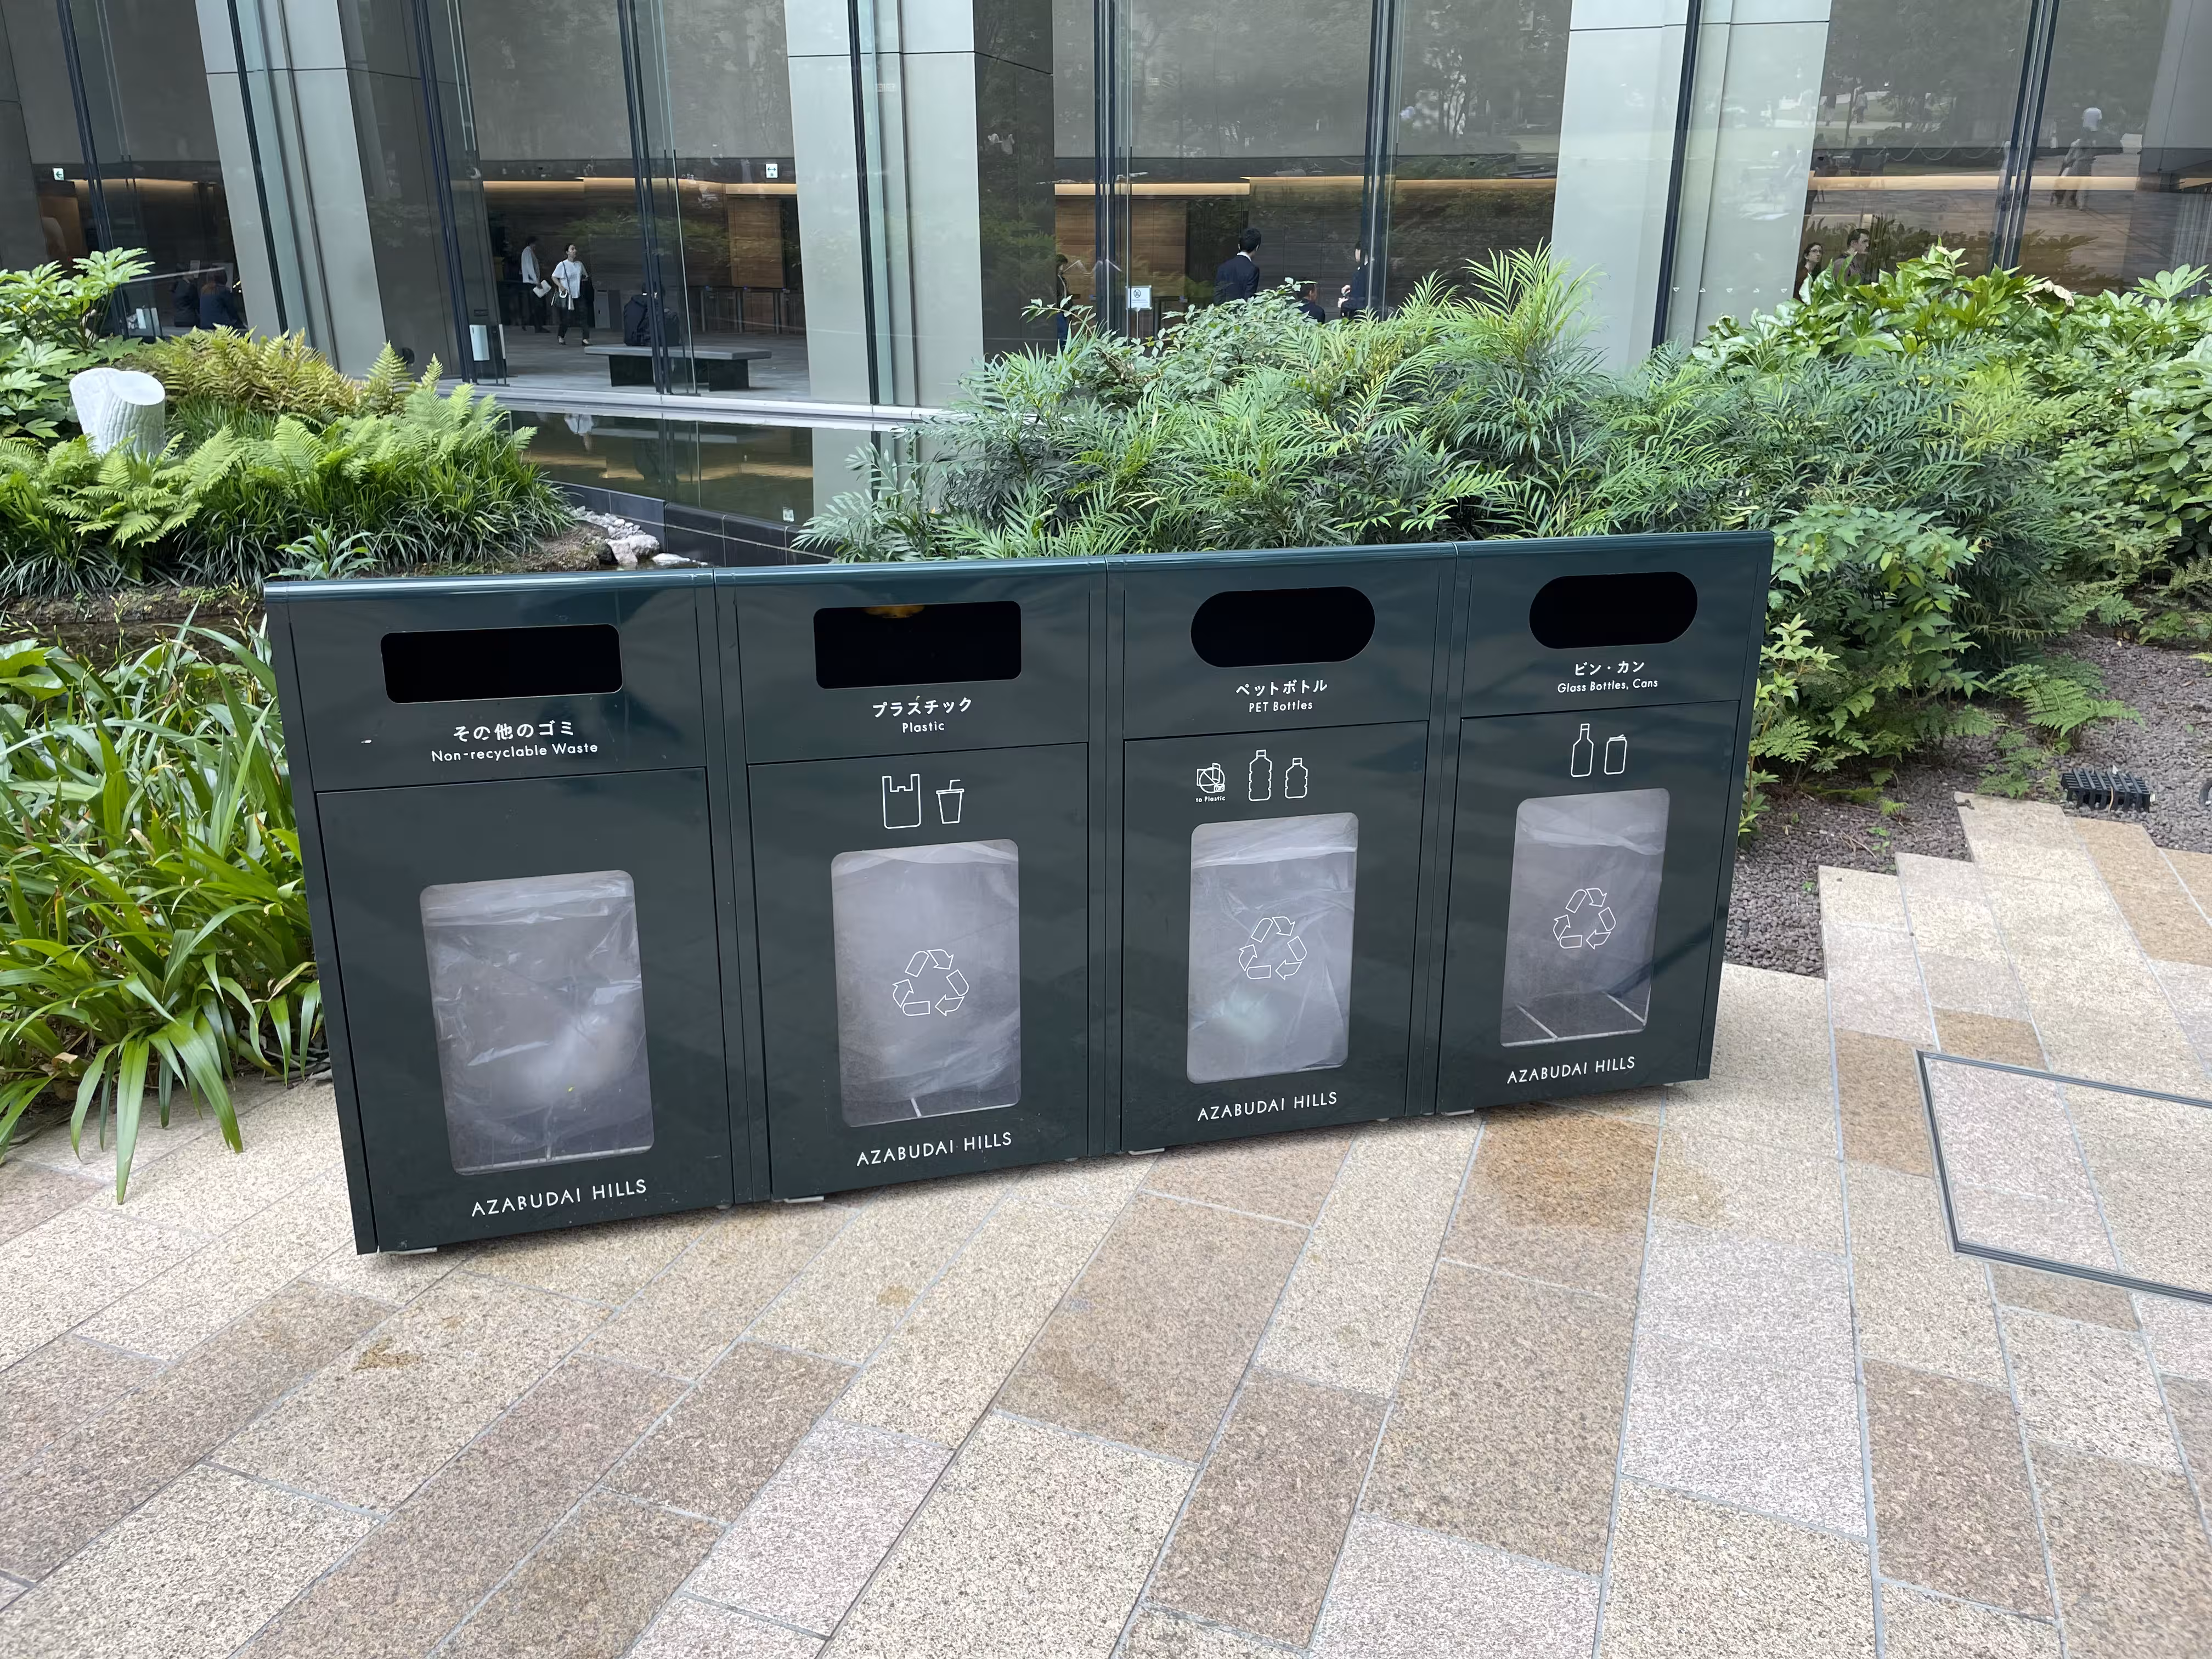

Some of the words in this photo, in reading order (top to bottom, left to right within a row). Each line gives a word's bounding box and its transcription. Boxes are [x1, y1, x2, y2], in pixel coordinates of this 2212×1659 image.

[1235, 679, 1328, 697] ペットボトル
[1557, 682, 1587, 693] Glass
[1590, 680, 1629, 691] Bottles,
[1632, 678, 1658, 689] Cans
[872, 697, 972, 718] プラスチック
[1249, 701, 1269, 713] PET
[1273, 699, 1313, 712] Bottles
[453, 720, 573, 742] その他のゴミ
[902, 721, 945, 733] Plastic
[431, 744, 547, 762] Non-recyclable
[551, 743, 598, 754] Waste
[1506, 1062, 1587, 1084] AZABUDAI
[1595, 1056, 1635, 1073] HILLS
[1197, 1098, 1284, 1121] AZABUDAI
[1294, 1091, 1337, 1109] HILLS
[856, 1139, 953, 1166] AZABUDAI
[964, 1132, 1012, 1151] HILLS
[471, 1188, 580, 1217] AZABUDAI
[592, 1178, 646, 1200] HILLS
